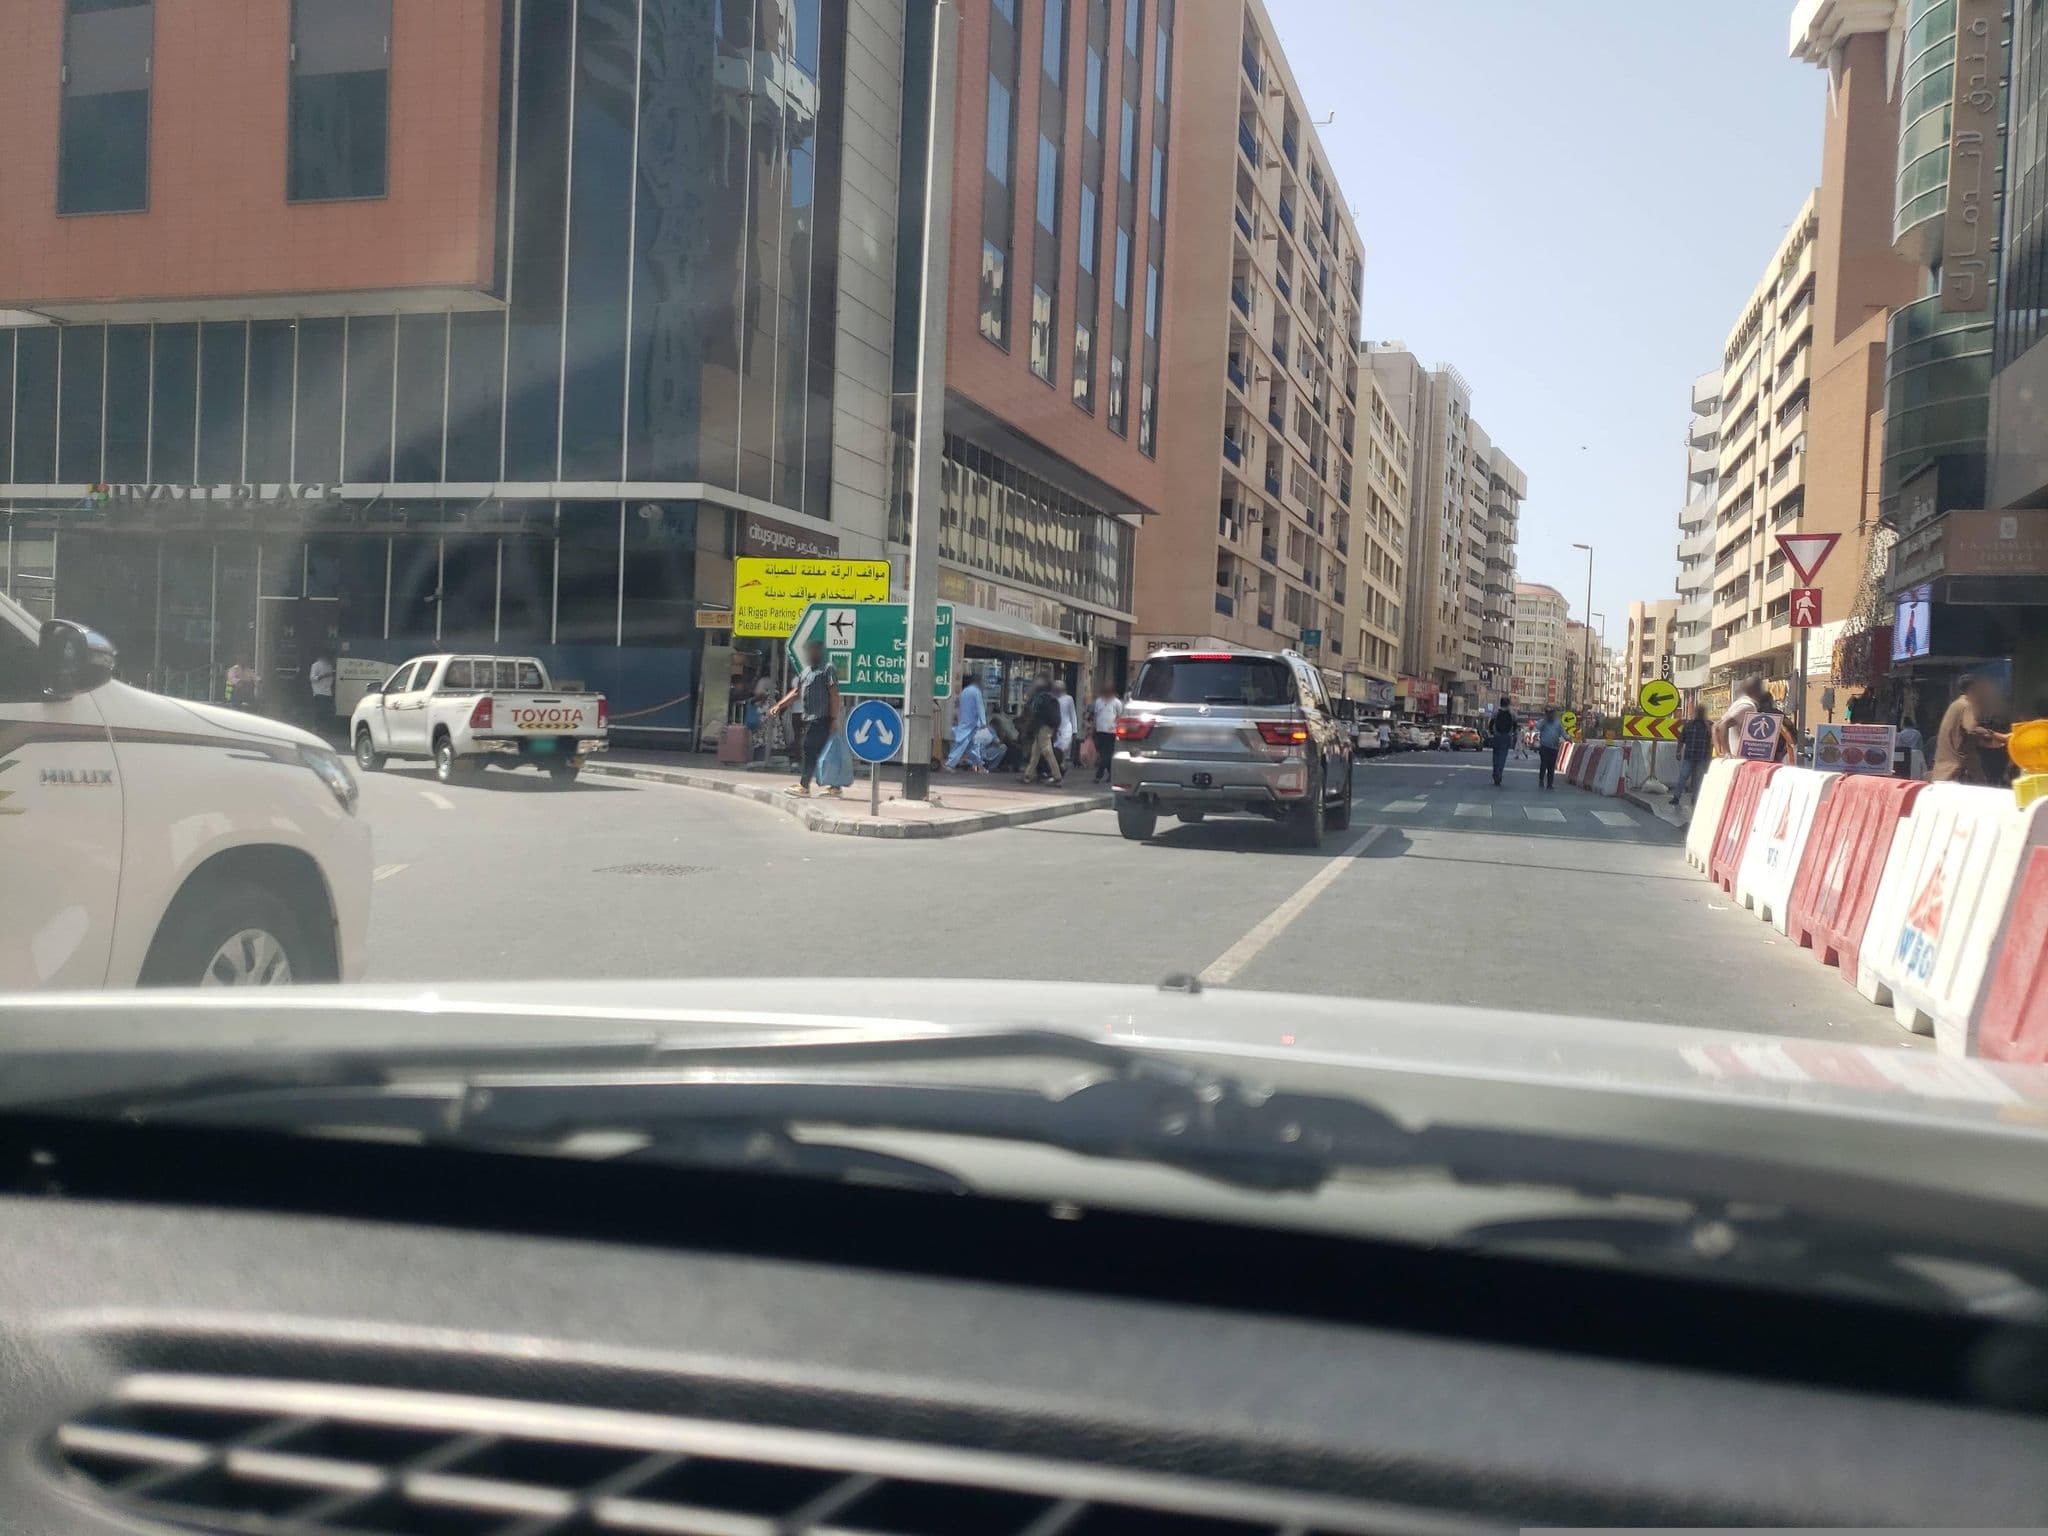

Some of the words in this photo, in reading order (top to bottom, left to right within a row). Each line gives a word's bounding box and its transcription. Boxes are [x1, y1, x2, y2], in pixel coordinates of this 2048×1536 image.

[1963, 17, 1995, 113] فندق
[1949, 131, 1986, 301] لاندمارك
[112, 484, 218, 505] HYATT
[231, 484, 343, 505] PLACE
[749, 523, 796, 552] citysquare
[765, 563, 797, 578] للصيانة
[801, 564, 827, 576] مغلقة
[831, 564, 852, 580] الرقة
[857, 566, 885, 580] مواقف
[764, 586, 785, 600] بديلة
[790, 587, 816, 601] مواقف
[820, 588, 857, 601] استخدام
[738, 606, 746, 617] Al
[749, 606, 768, 619] Rigga
[770, 608, 796, 620] Parking
[738, 620, 761, 631] Please
[763, 621, 777, 631] Use
[1147, 641, 1190, 651] RIDGID
[857, 654, 872, 666] Al
[876, 655, 906, 667] Garh
[857, 670, 871, 683] Al
[512, 709, 583, 722] TOYOTA
[40, 769, 113, 785] HILUX
